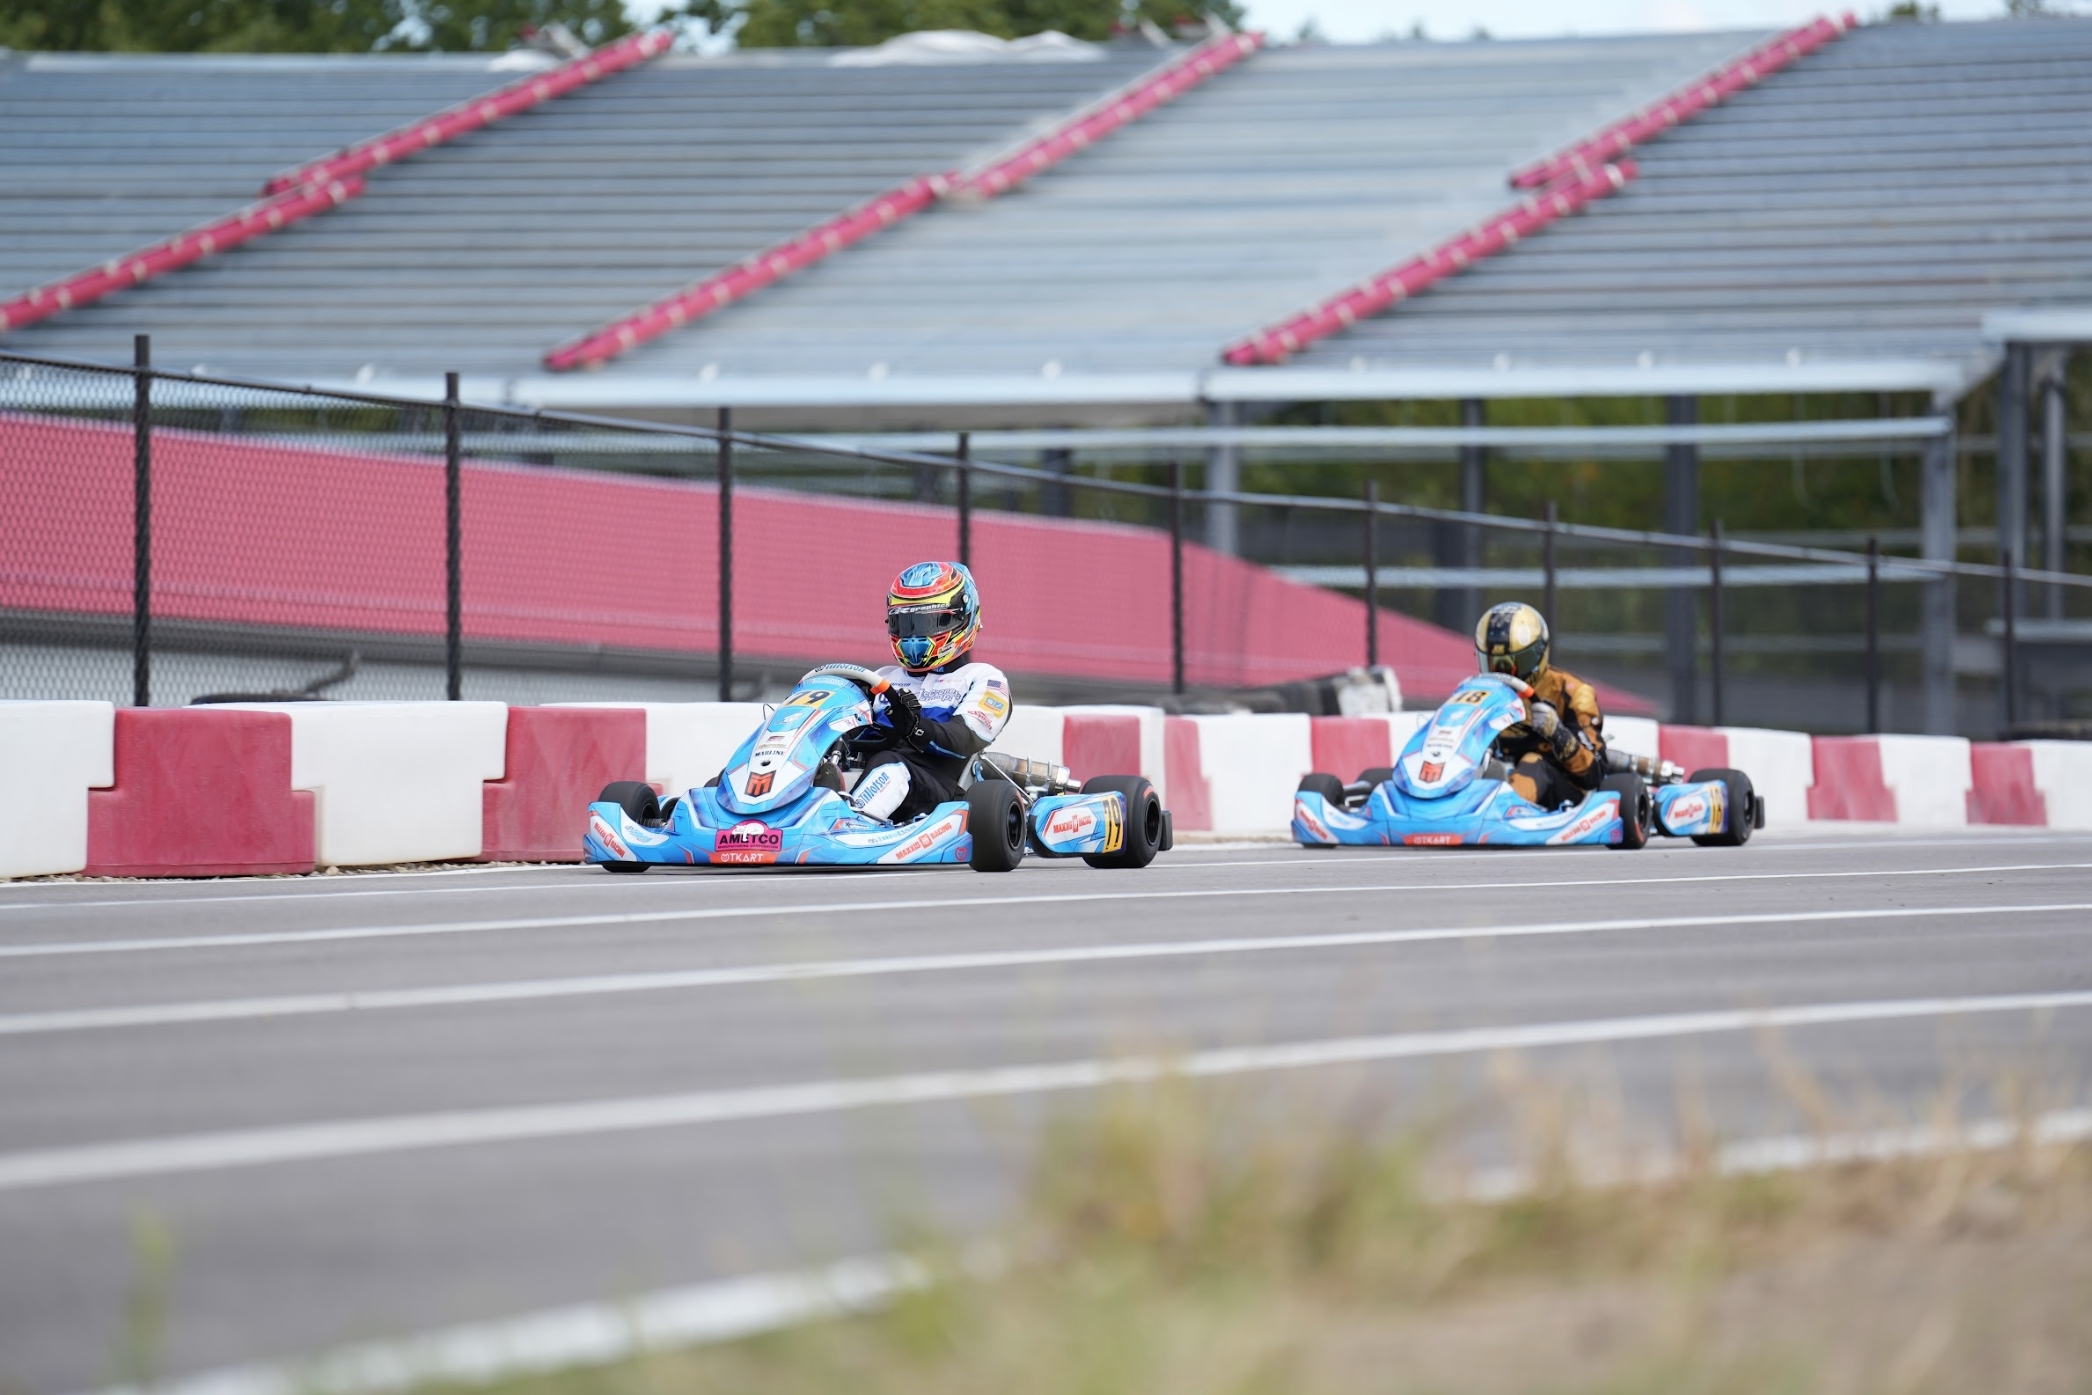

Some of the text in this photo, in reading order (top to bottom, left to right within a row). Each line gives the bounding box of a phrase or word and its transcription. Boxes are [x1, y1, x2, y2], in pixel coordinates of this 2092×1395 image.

[858, 772, 890, 804] Tillotson
[719, 834, 779, 845] AMETCO
[930, 822, 953, 840] RACING
